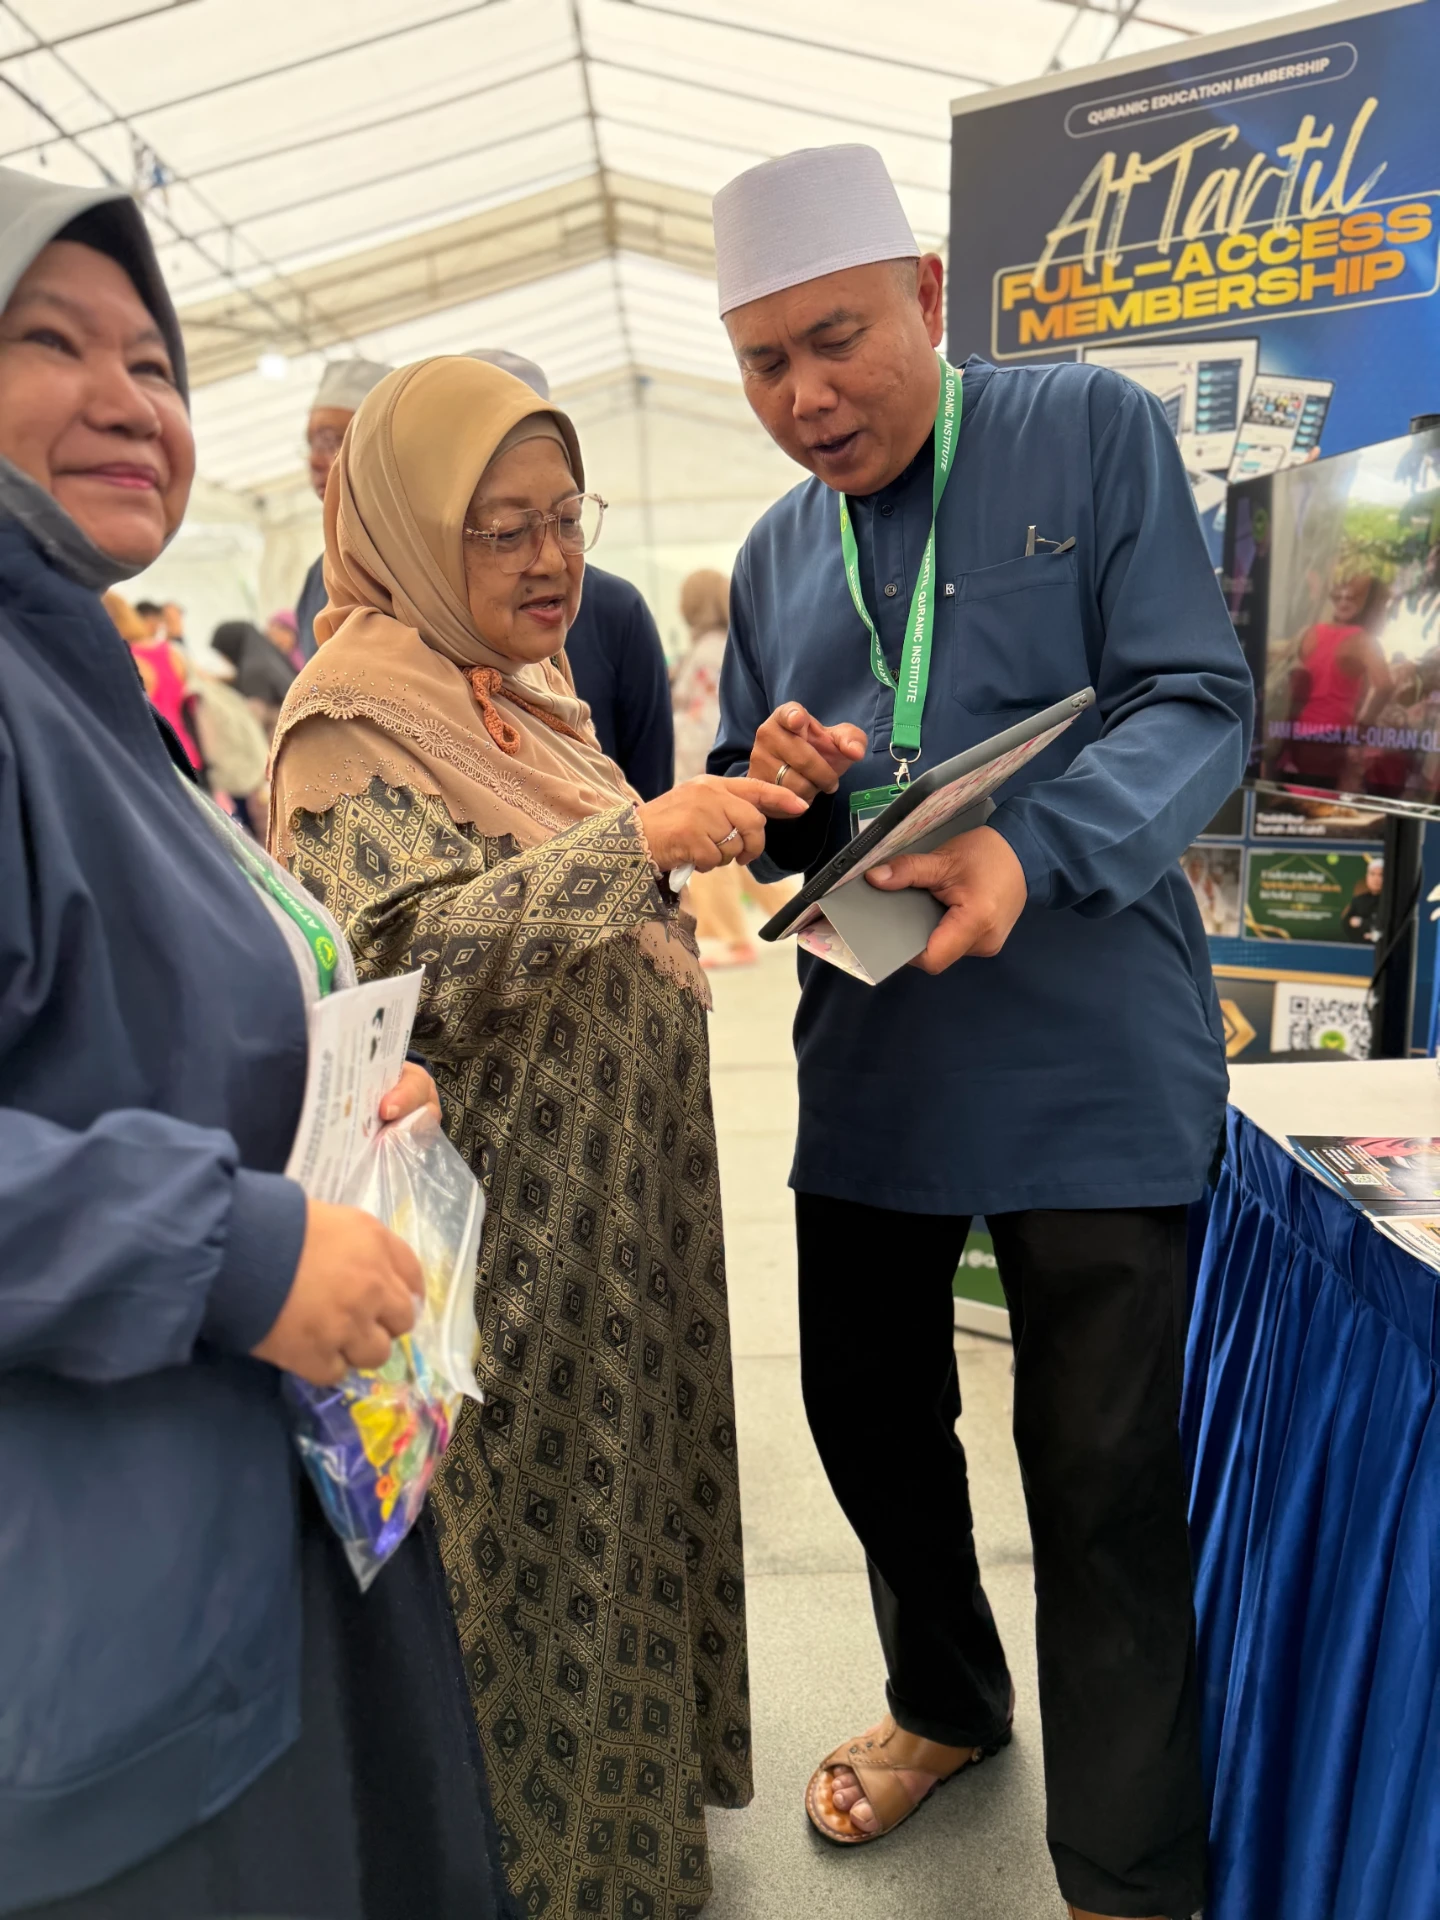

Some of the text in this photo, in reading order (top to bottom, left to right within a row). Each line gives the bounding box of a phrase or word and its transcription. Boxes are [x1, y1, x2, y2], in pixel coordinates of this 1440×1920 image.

[1087, 57, 1331, 125] QURANIC EDUCATION MEMBERSHIP
[1019, 250, 1406, 344] MEMBERSHIP
[945, 379, 955, 418] QURANIC
[941, 420, 954, 472] INSTITUTE
[913, 591, 927, 643] QURANIC
[906, 645, 921, 703] INSTITUTE
